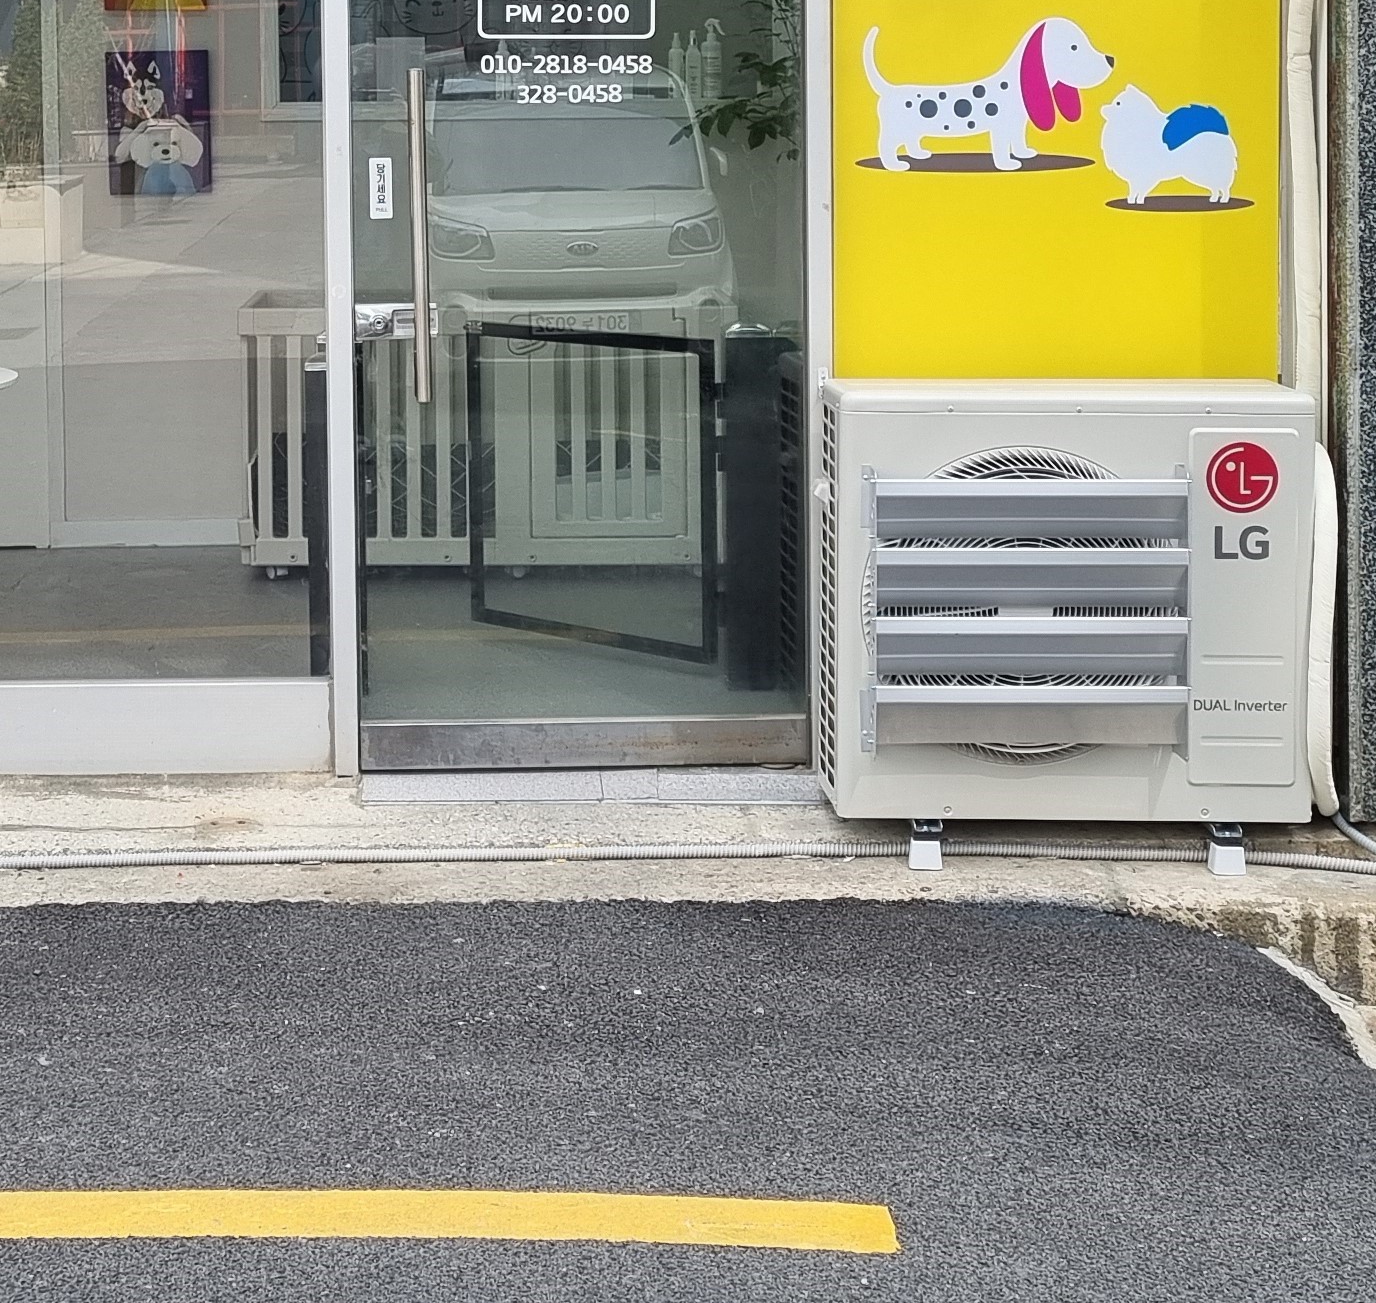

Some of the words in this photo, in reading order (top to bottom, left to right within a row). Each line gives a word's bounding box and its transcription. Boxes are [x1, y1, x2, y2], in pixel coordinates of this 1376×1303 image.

[504, 3, 542, 24] PM
[550, 3, 630, 24] 20:00
[480, 54, 653, 75] 010-2818-0458
[516, 83, 623, 104] 328-0458
[375, 163, 387, 204] 당기세요
[1214, 525, 1270, 561] LG
[1193, 699, 1231, 712] DUAL
[1234, 699, 1288, 712] Inverter
